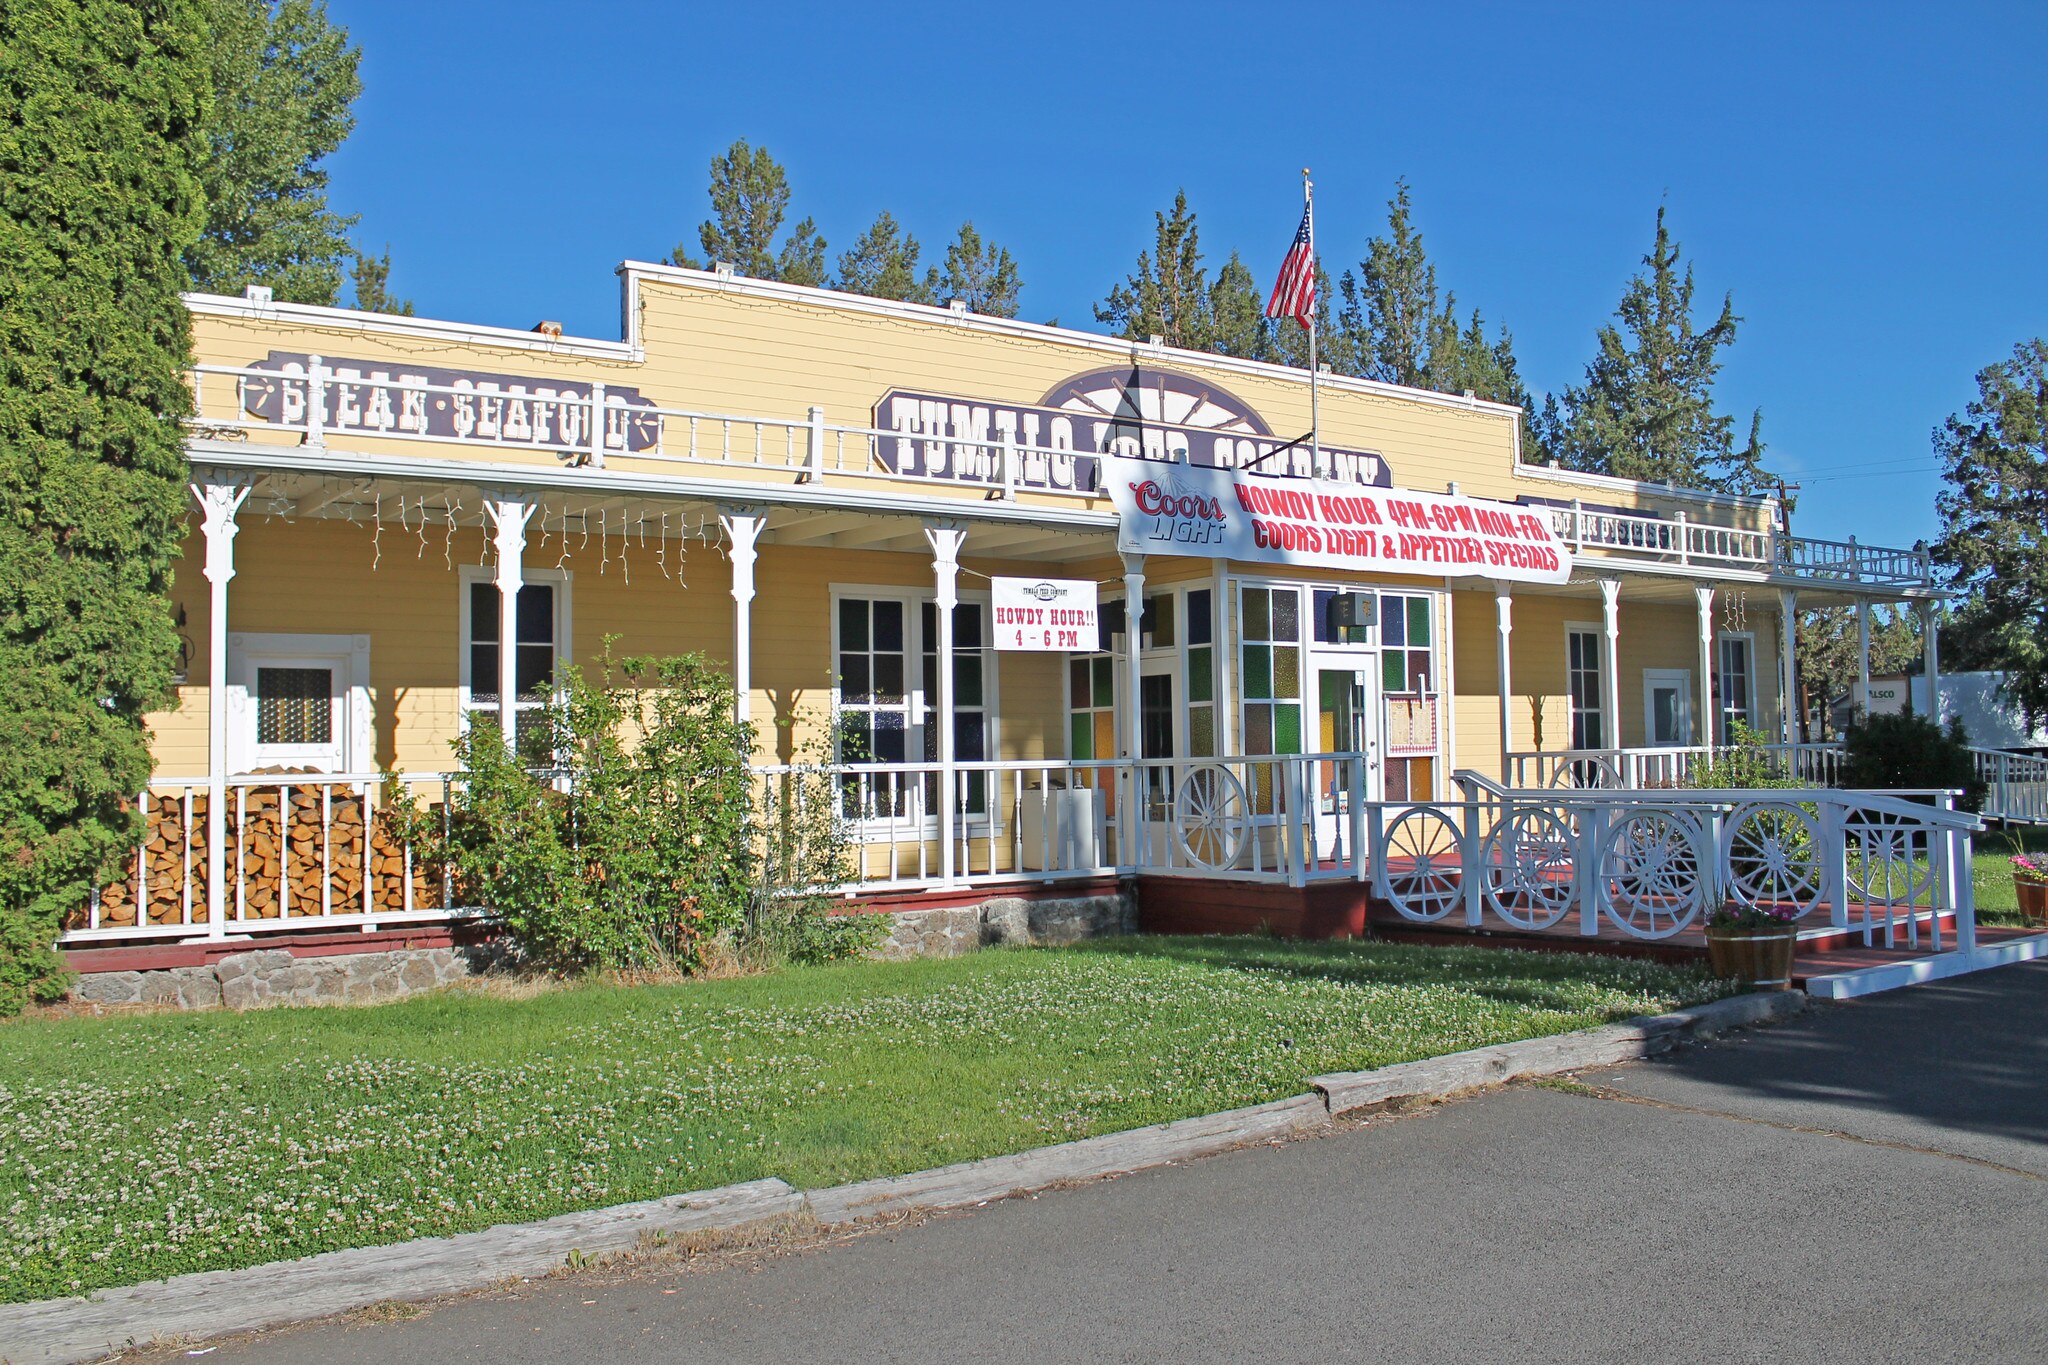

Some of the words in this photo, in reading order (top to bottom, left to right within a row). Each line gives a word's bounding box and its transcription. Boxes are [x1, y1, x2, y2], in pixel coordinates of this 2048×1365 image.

[453, 379, 630, 447] SEAFOD
[891, 397, 1074, 487] TUMALO
[1128, 480, 1226, 521] Coors
[1233, 483, 1317, 521] HOWDY
[1317, 495, 1383, 525] HOUR
[1386, 499, 1477, 533] 4PM-6PM
[1148, 517, 1226, 543] LIGHT
[1251, 519, 1322, 553] COORS
[1321, 527, 1377, 558] LIGHT
[1382, 535, 1397, 559] &
[1398, 532, 1486, 564] APPETIZER
[1484, 540, 1559, 571] SPECIALS
[1601, 516, 1656, 543] OYSES
[997, 607, 1043, 625] HOWDY
[1050, 608, 1094, 627] HOUR!!
[1015, 629, 1023, 647] 4
[1044, 629, 1051, 647] 6
[1058, 630, 1078, 647] PM
